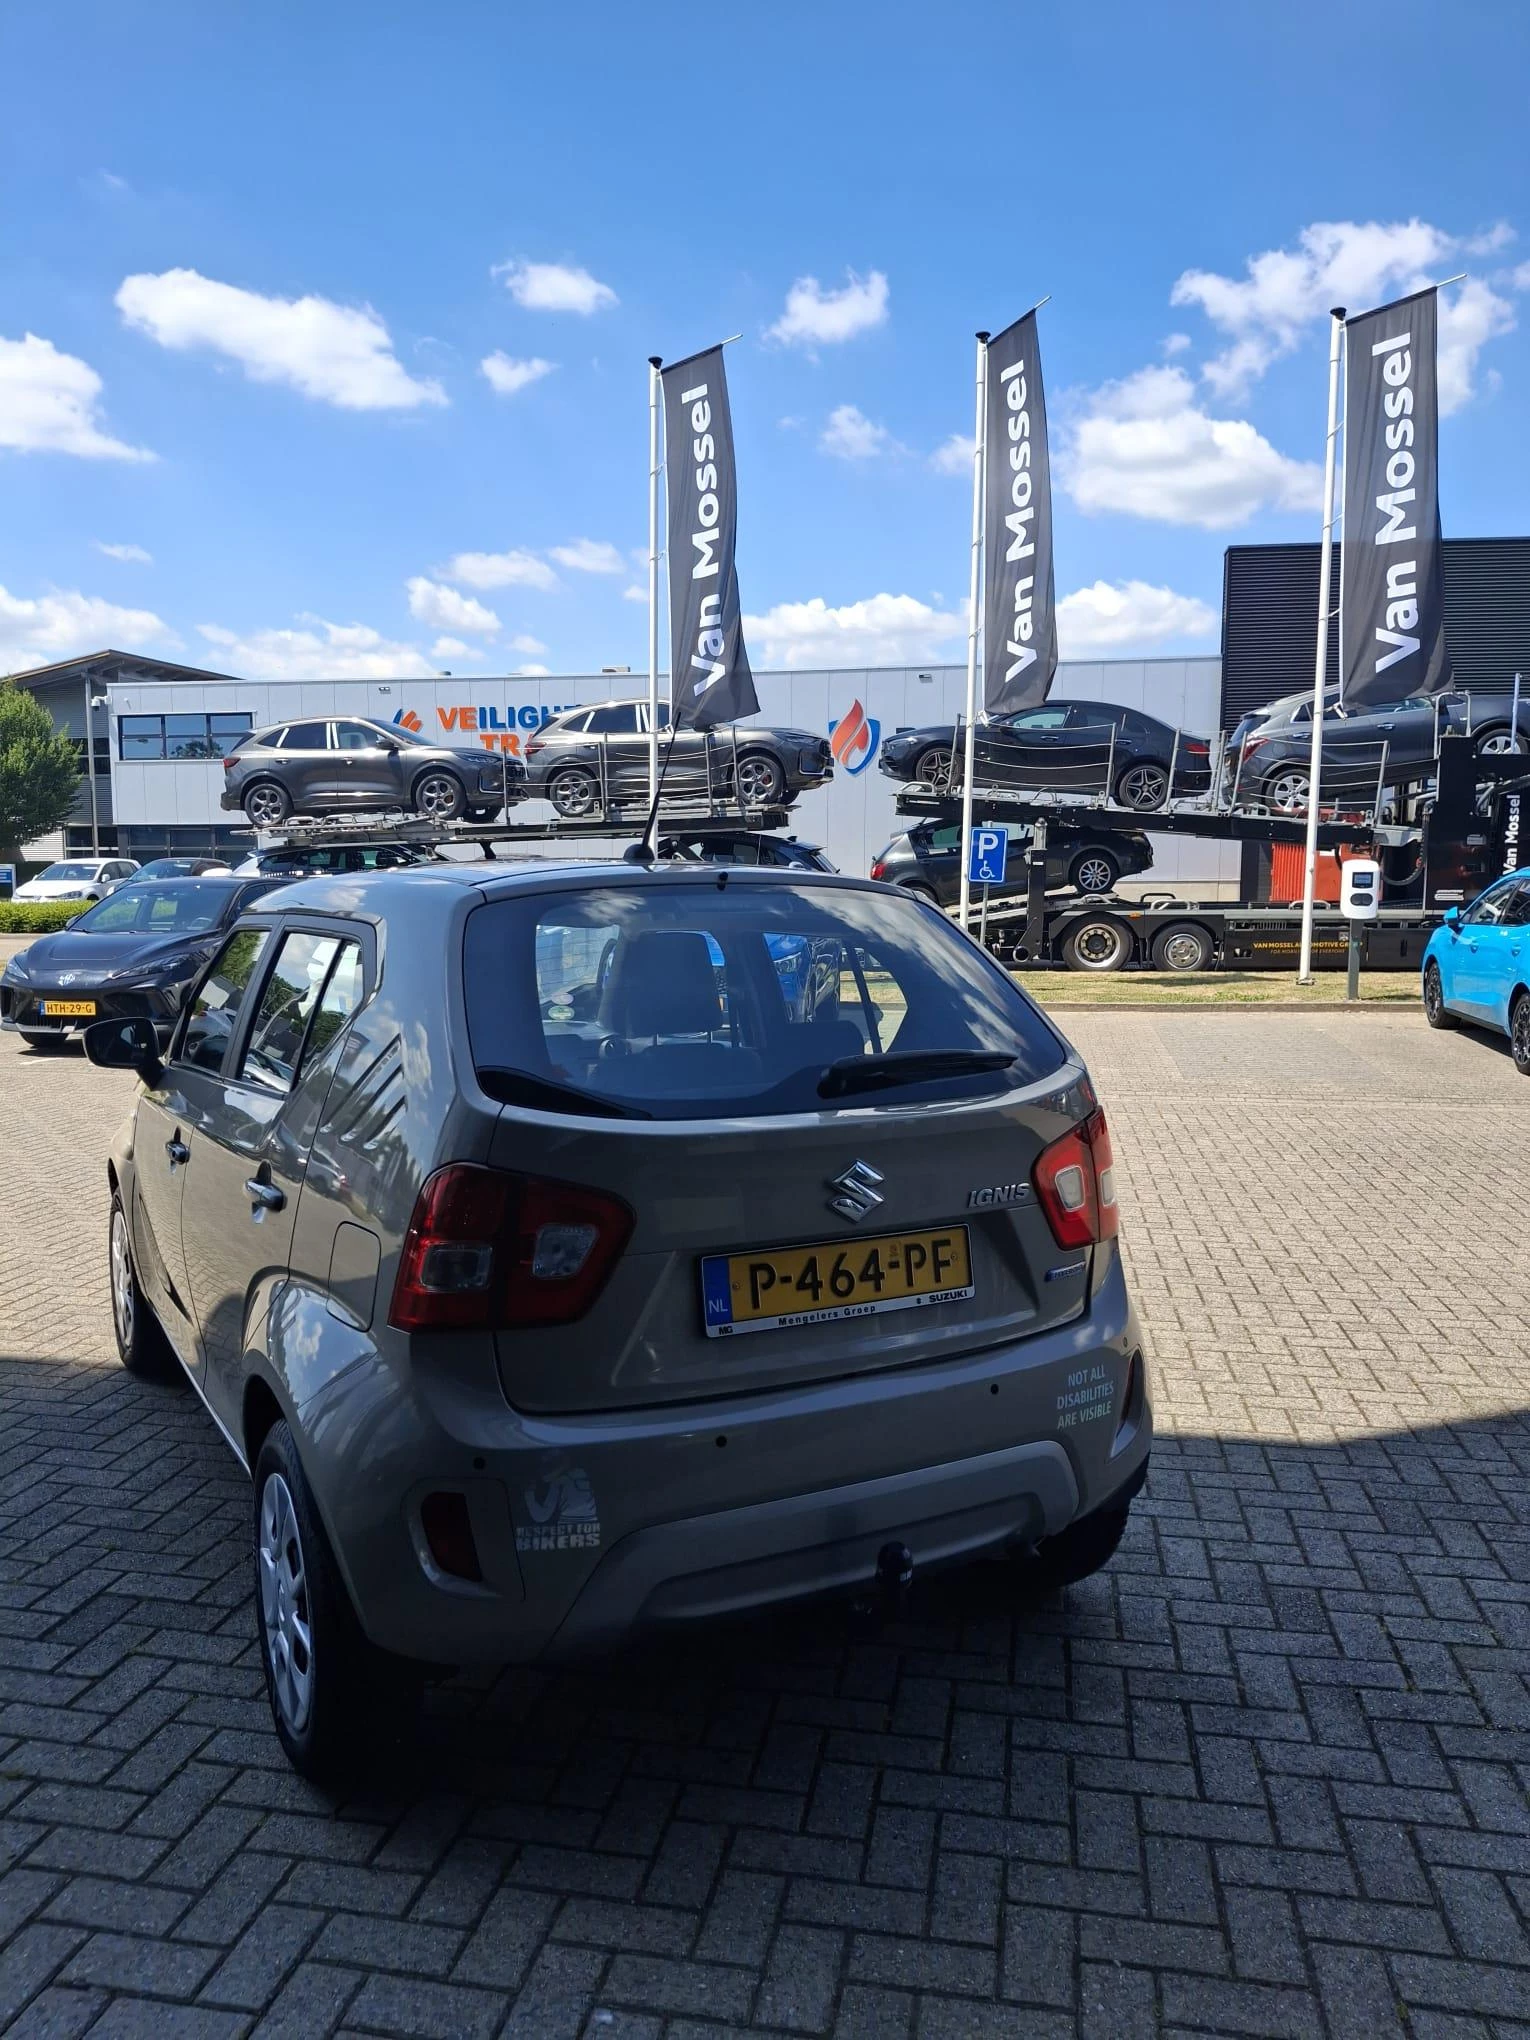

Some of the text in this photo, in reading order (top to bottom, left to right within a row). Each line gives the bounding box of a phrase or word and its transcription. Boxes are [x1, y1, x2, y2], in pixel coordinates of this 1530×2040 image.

[1371, 332, 1421, 674] Van Mossel
[1000, 359, 1038, 683] Van Mossel
[681, 383, 726, 698] Van Mossel
[978, 832, 999, 860] P
[1502, 794, 1521, 876] Van Mossel
[46, 1003, 92, 1014] HTH-29-G
[968, 1182, 1030, 1208] IGNIS
[749, 1239, 952, 1310] P-464-PF
[708, 1299, 728, 1314] NL
[929, 1289, 968, 1303] SUZUKI
[778, 1305, 876, 1326] Mengelers Groep
[718, 1326, 733, 1335] MG
[1067, 1364, 1105, 1387] NOT ALL
[1056, 1381, 1114, 1410] DISABILITIES
[1057, 1400, 1112, 1430] ARE VISIBLE
[516, 1533, 601, 1551] BIKERS
